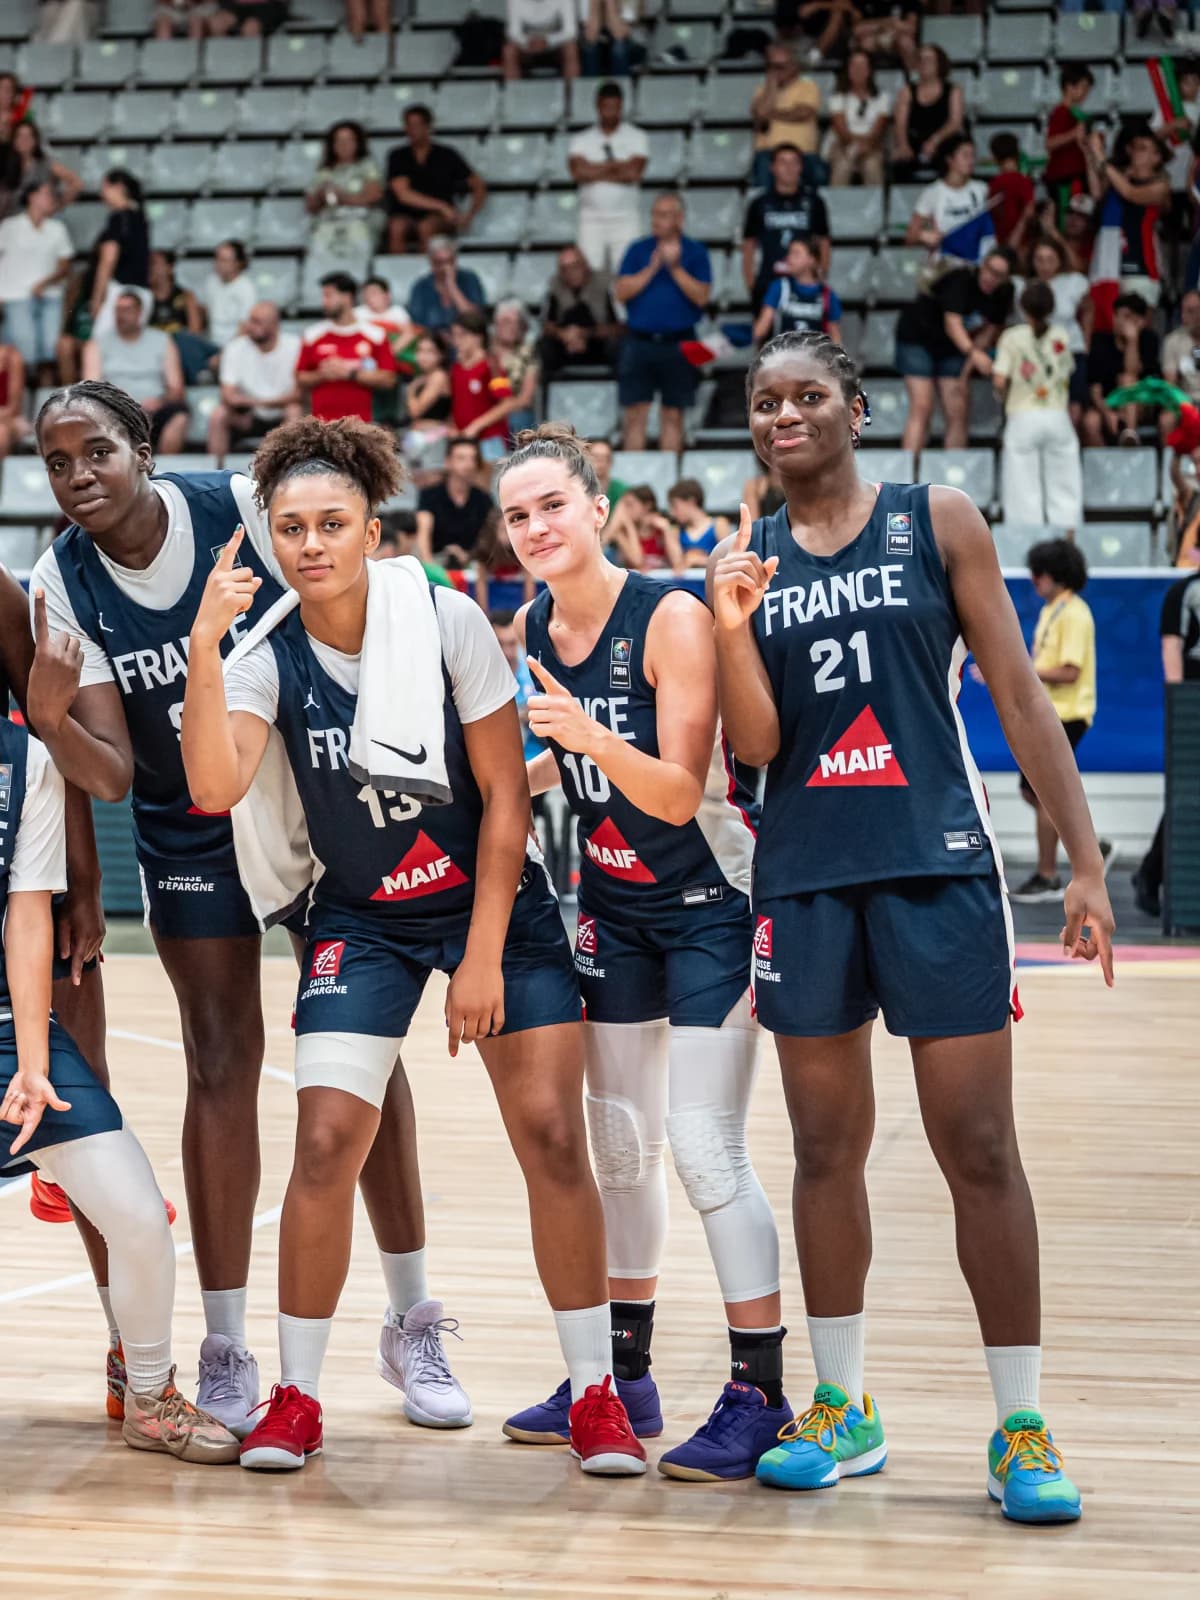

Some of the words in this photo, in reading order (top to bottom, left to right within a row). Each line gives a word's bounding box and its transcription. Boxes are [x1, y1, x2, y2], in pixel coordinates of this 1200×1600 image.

[763, 564, 909, 636] FRANCE
[112, 612, 250, 695] FRAE
[809, 630, 872, 693] 21
[562, 753, 611, 803] 10
[819, 744, 892, 778] MAIF
[585, 838, 637, 869] MAIF
[158, 880, 215, 892] D'EPARGNE
[381, 855, 451, 895] MAIF
[309, 976, 336, 988] CAISSE
